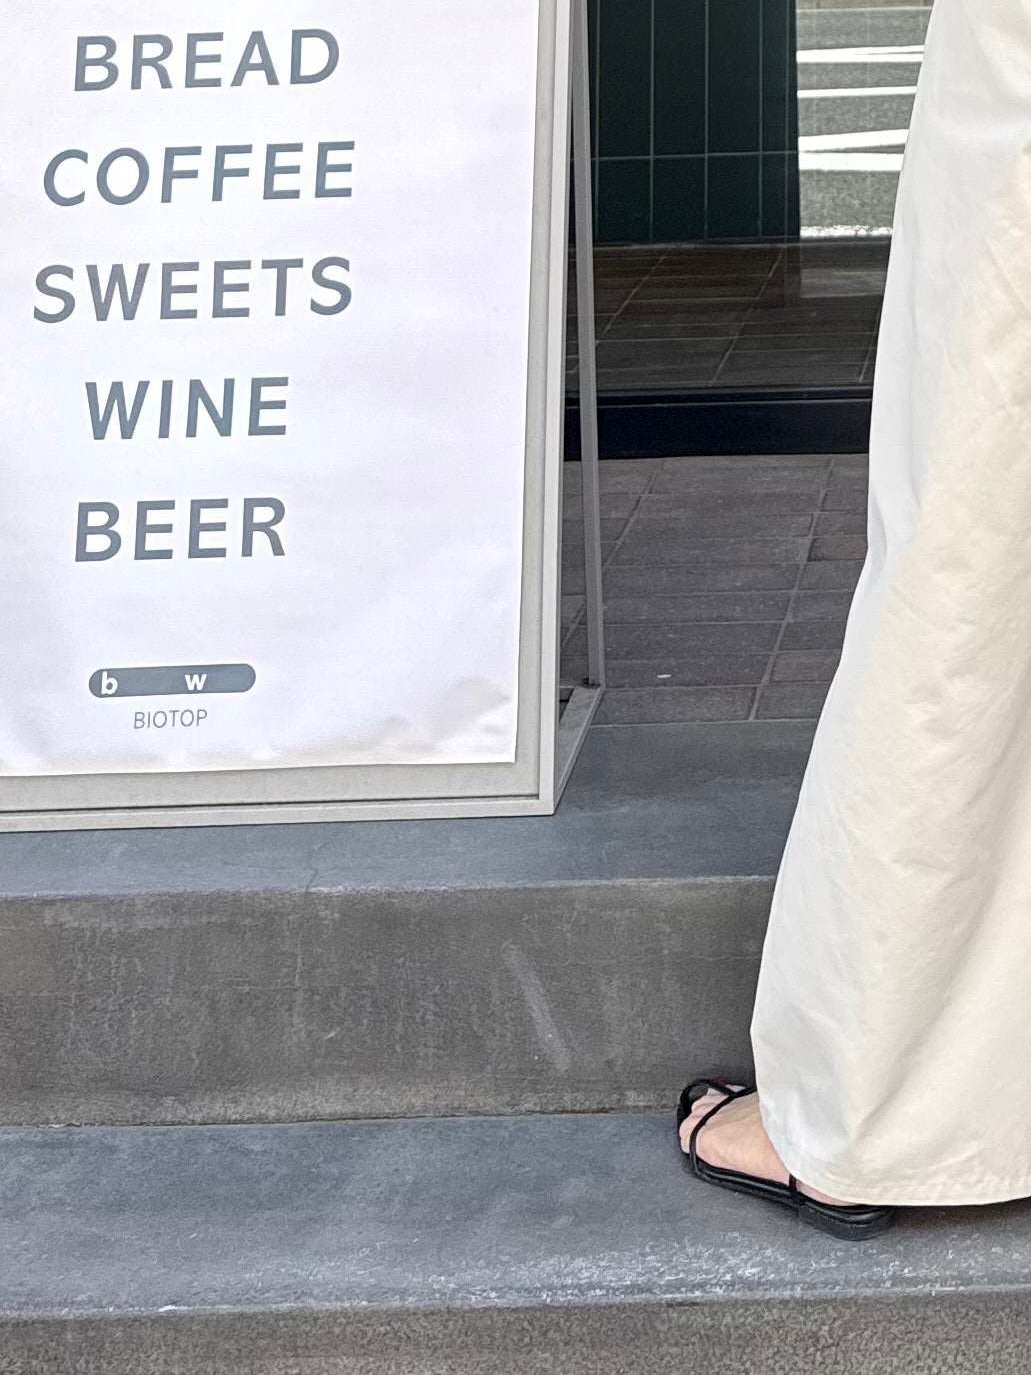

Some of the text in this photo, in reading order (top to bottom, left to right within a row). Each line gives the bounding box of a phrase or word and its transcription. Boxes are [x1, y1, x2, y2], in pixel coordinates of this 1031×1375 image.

[74, 28, 340, 92] BREAD
[43, 140, 355, 207] COFFEE
[33, 256, 352, 324] SWEETS
[85, 376, 289, 441] WINE
[74, 497, 286, 563] BEER
[101, 670, 207, 695] b w
[133, 708, 208, 730] BIOTOP
